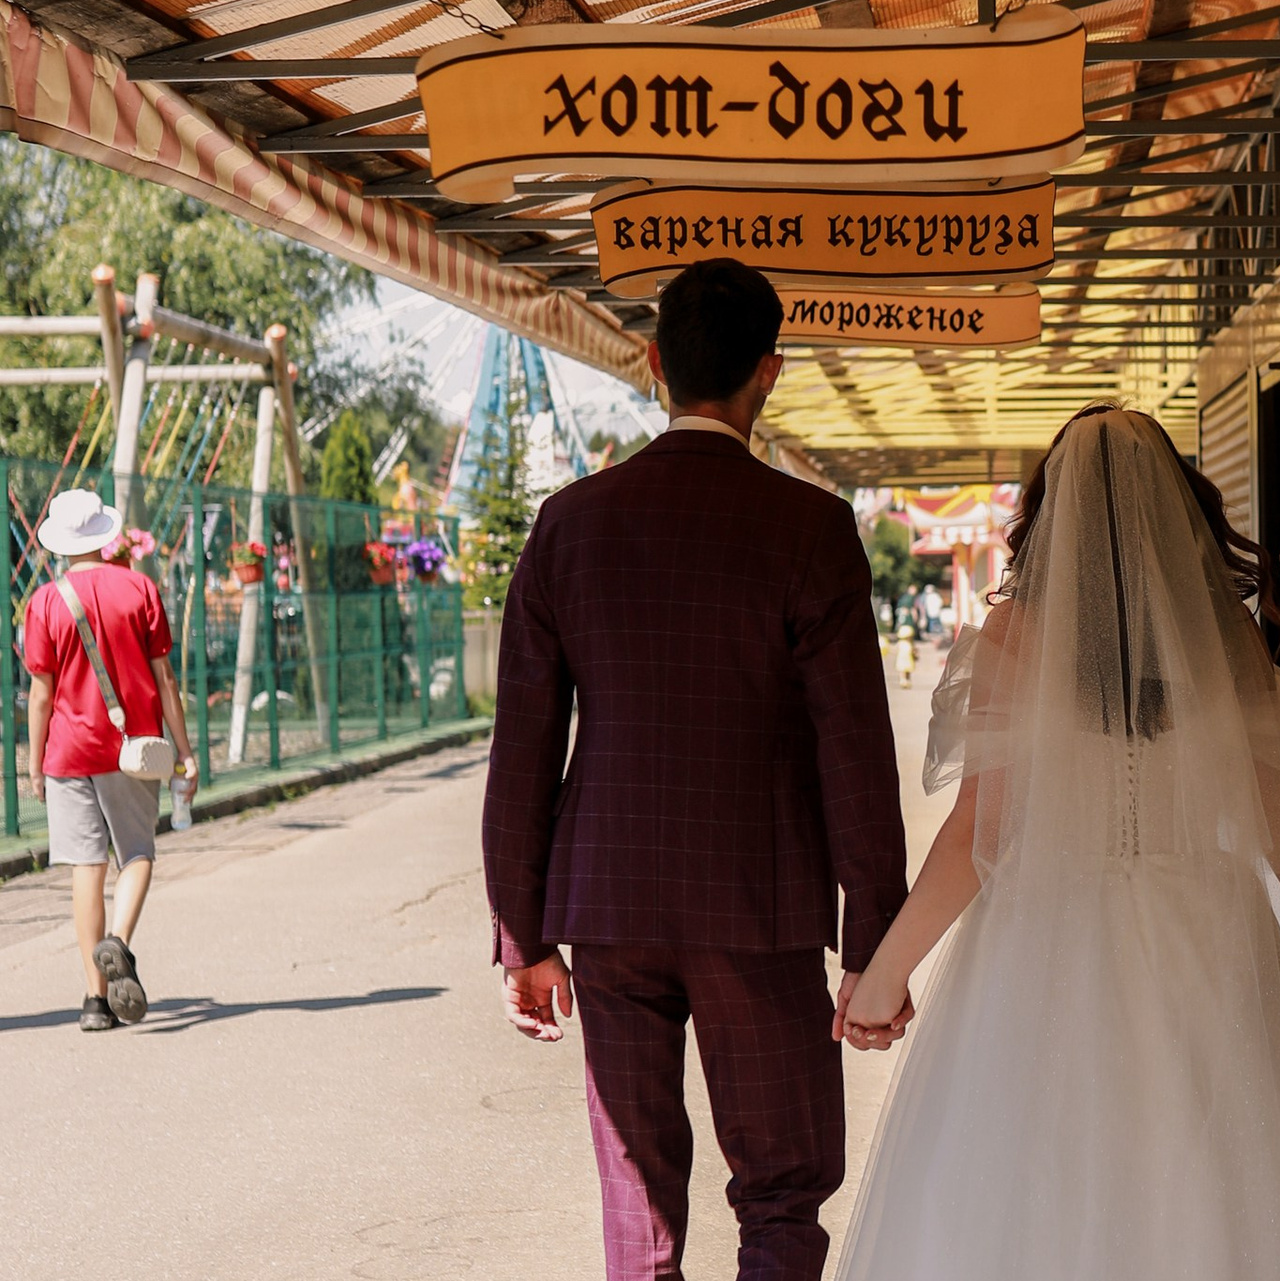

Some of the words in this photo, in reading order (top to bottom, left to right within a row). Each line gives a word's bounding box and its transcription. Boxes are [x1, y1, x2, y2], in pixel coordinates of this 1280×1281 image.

[543, 61, 968, 143] хот-доги
[613, 211, 805, 258] вареная
[827, 211, 1041, 258] кукуруза
[787, 298, 985, 335] мороженое
